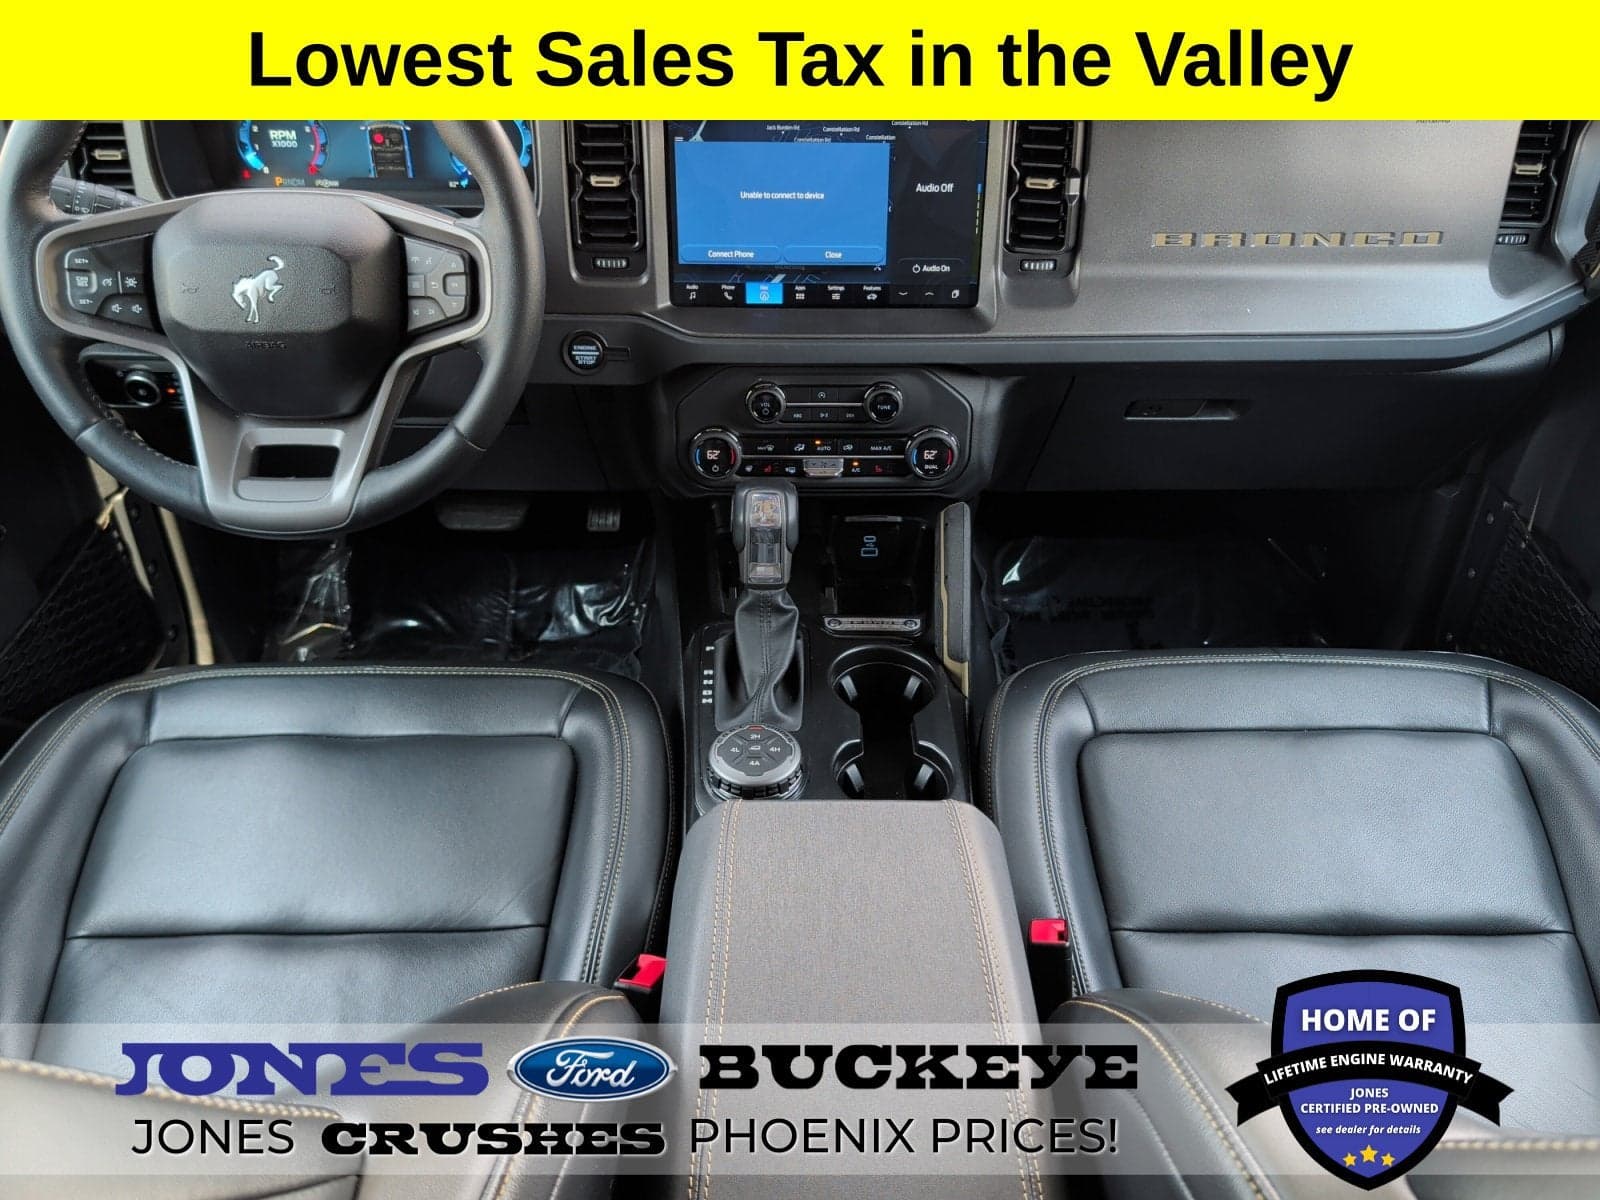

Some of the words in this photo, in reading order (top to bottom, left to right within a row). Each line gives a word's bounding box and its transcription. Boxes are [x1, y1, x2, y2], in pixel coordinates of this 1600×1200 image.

[269, 129, 297, 140] RPM
[865, 132, 896, 140] Constellation
[915, 183, 940, 193] Audio
[940, 183, 954, 193] Off
[740, 191, 762, 199] Unable
[804, 191, 825, 199] device
[1151, 231, 1443, 248] BRONCO
[708, 249, 733, 259] Connect
[733, 249, 755, 259] Phone
[825, 250, 842, 260] Close
[922, 263, 940, 272] Audio
[940, 264, 951, 272] On
